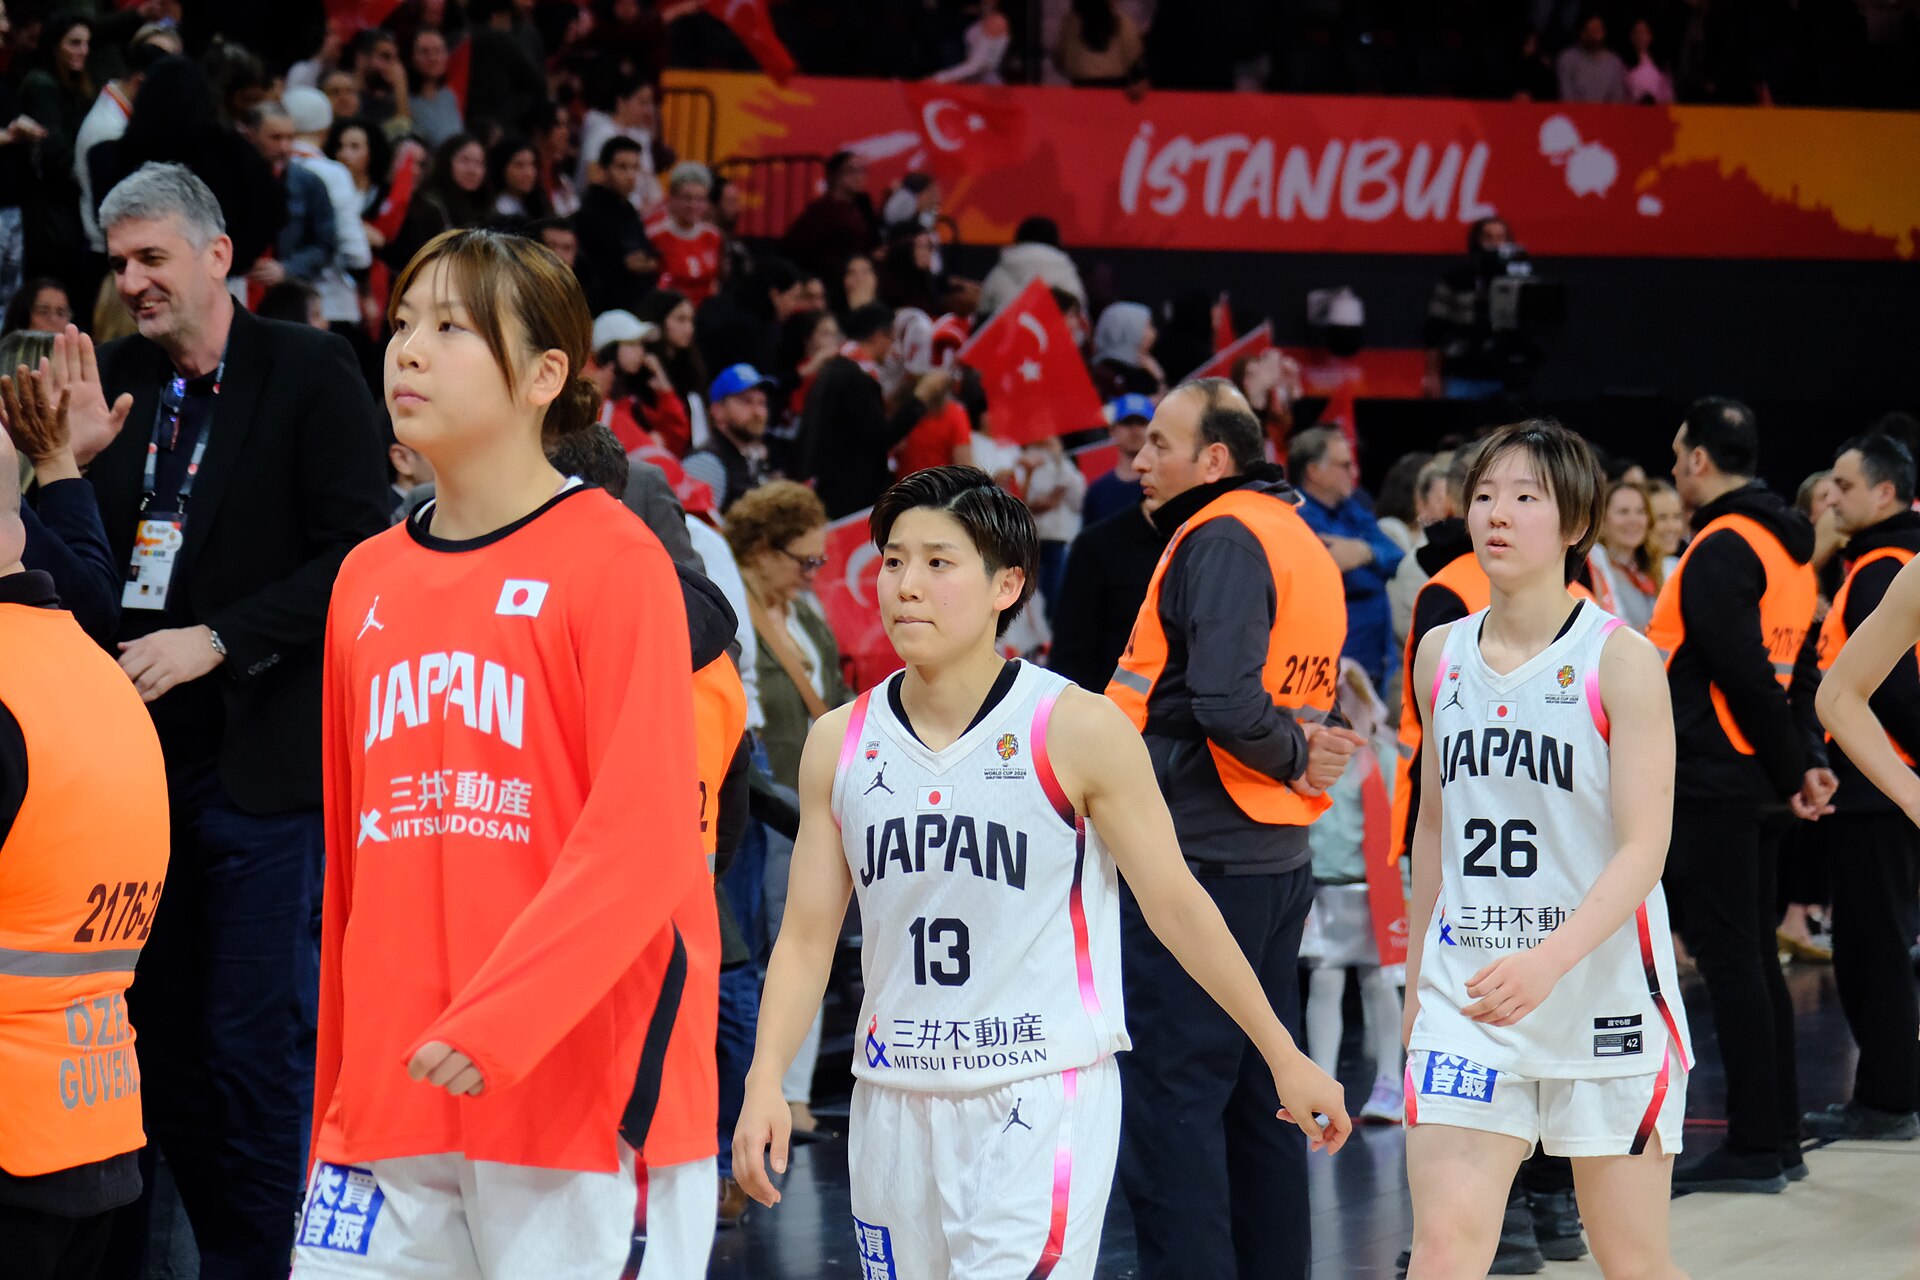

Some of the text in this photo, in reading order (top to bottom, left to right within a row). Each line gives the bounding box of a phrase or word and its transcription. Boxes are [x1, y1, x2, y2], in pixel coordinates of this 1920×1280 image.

[1119, 121, 1497, 222] İSTANBUL
[364, 651, 524, 754] JAPAN
[1440, 728, 1574, 793] JAPAN
[859, 813, 1028, 891] JAPAN
[1463, 818, 1538, 878] 26
[1458, 905, 1575, 932] 三井不動
[1460, 935, 1511, 949] MITSUI
[908, 916, 971, 987] 13
[892, 1012, 1046, 1051] 三井不動産
[893, 1047, 1048, 1071] MITSUI FUDOSAN
[1626, 1038, 1638, 1048] 42
